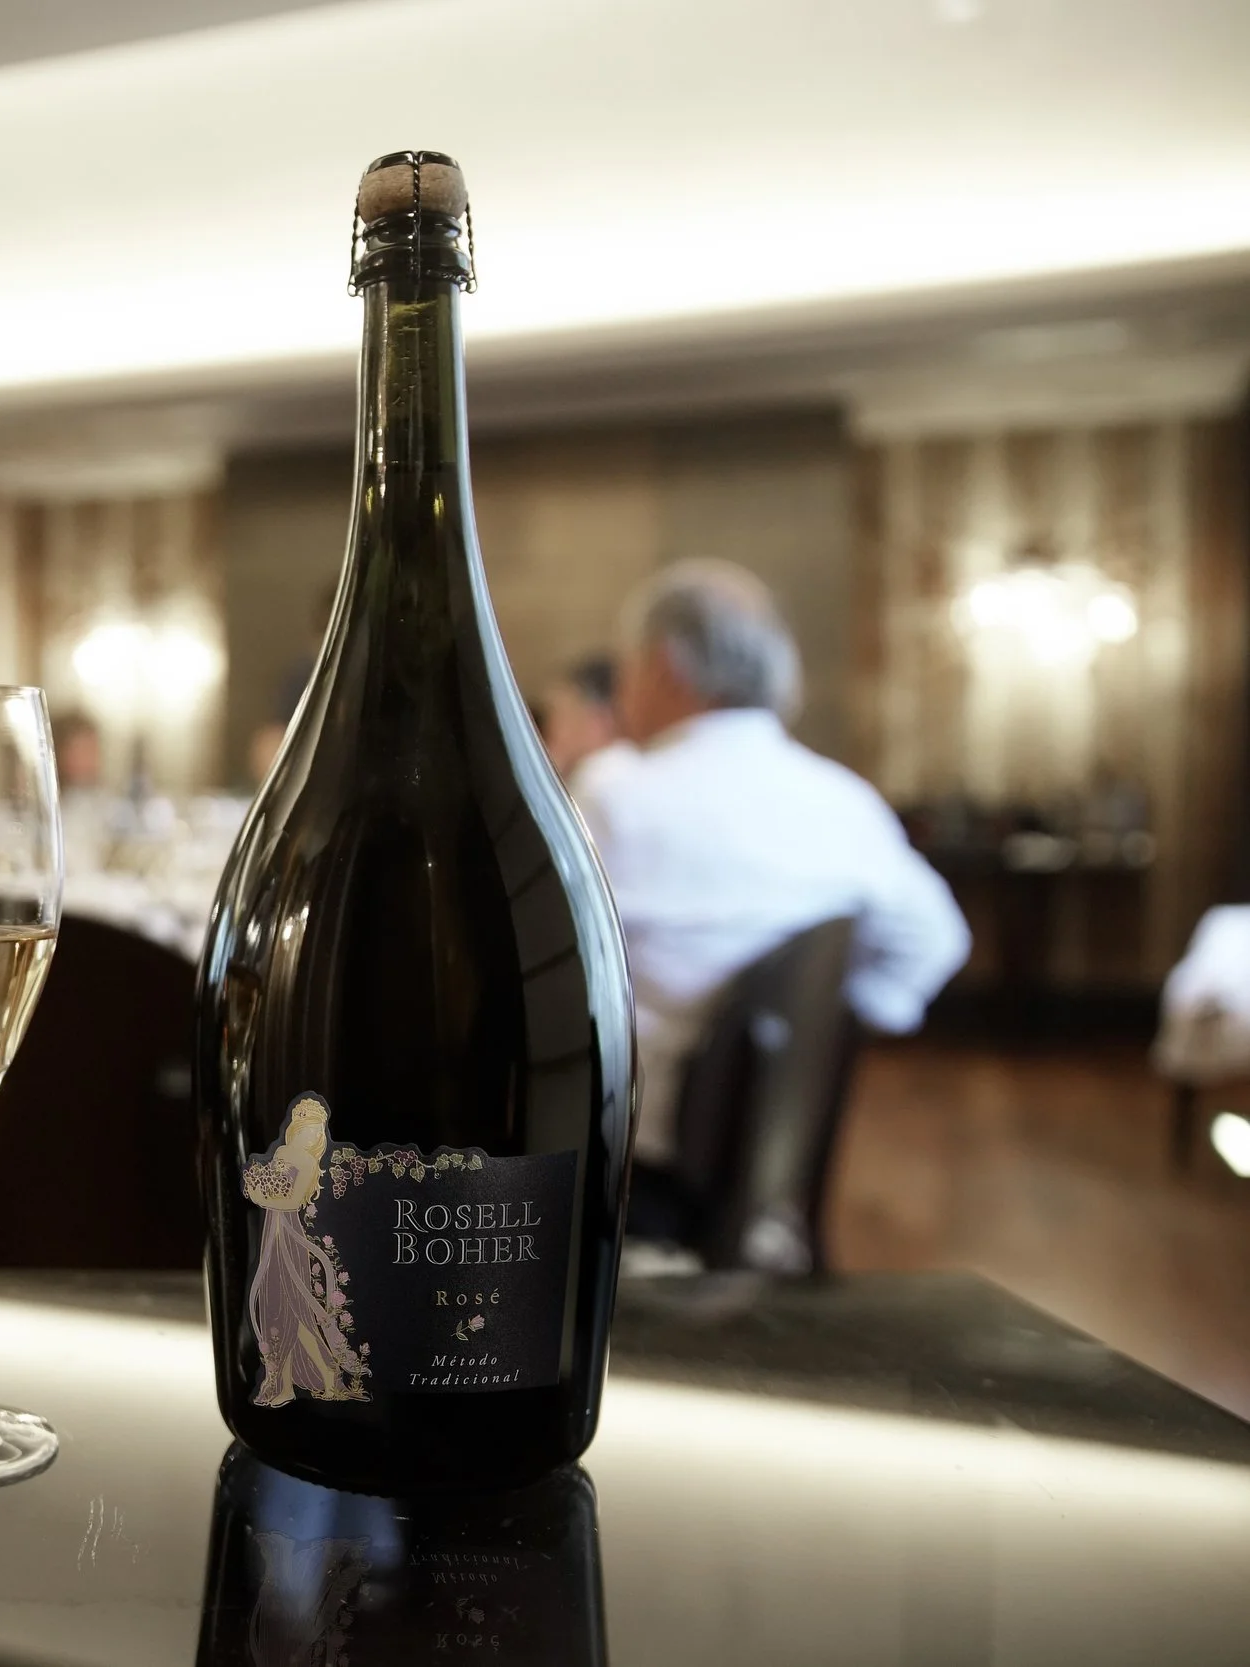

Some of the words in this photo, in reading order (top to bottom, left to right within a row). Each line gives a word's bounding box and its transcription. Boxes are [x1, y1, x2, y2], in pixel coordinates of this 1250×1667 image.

[393, 1199, 541, 1233] ROSELL
[392, 1232, 540, 1265] BOHER
[435, 1288, 500, 1306] Rosé
[431, 1353, 498, 1367] Método
[410, 1369, 520, 1385] Tradicional
